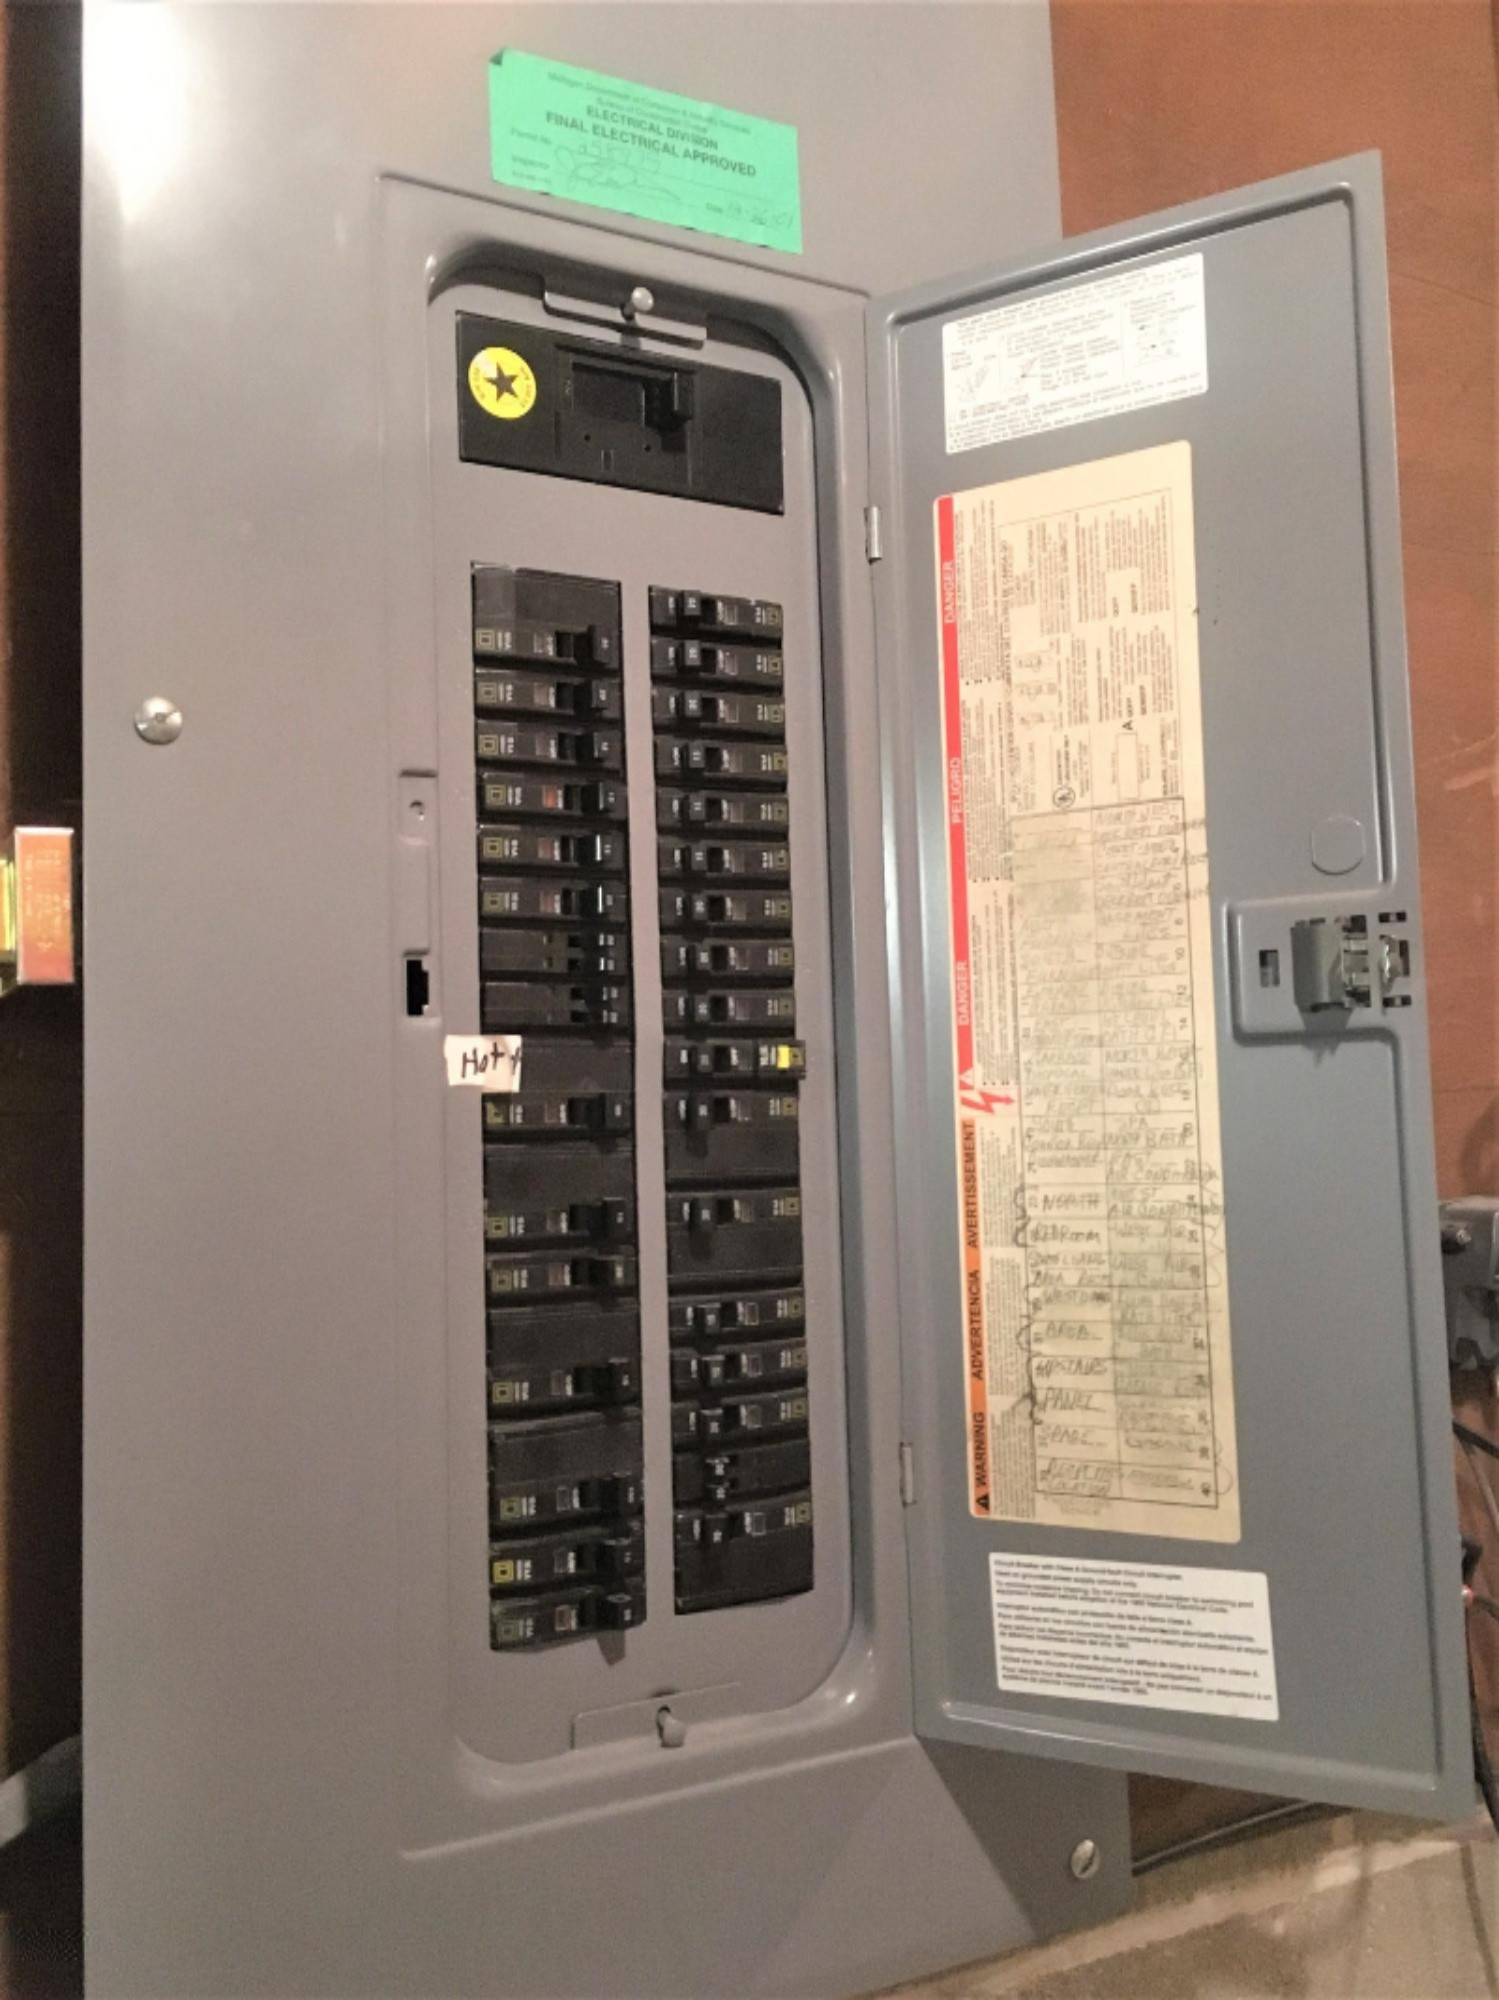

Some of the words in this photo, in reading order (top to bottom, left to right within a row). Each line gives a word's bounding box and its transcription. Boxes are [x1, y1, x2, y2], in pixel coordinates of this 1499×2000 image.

[545, 110, 589, 134] FINAL
[591, 123, 679, 159] ELECTRICAL
[682, 147, 756, 177] APPROVED
[586, 105, 664, 139] ELECTRICAL
[942, 561, 954, 624] DANGER
[963, 1121, 979, 1248] AVERTISSEMENT
[970, 1269, 982, 1380] ADVERTENCIA
[973, 1411, 988, 1488] WARNING
